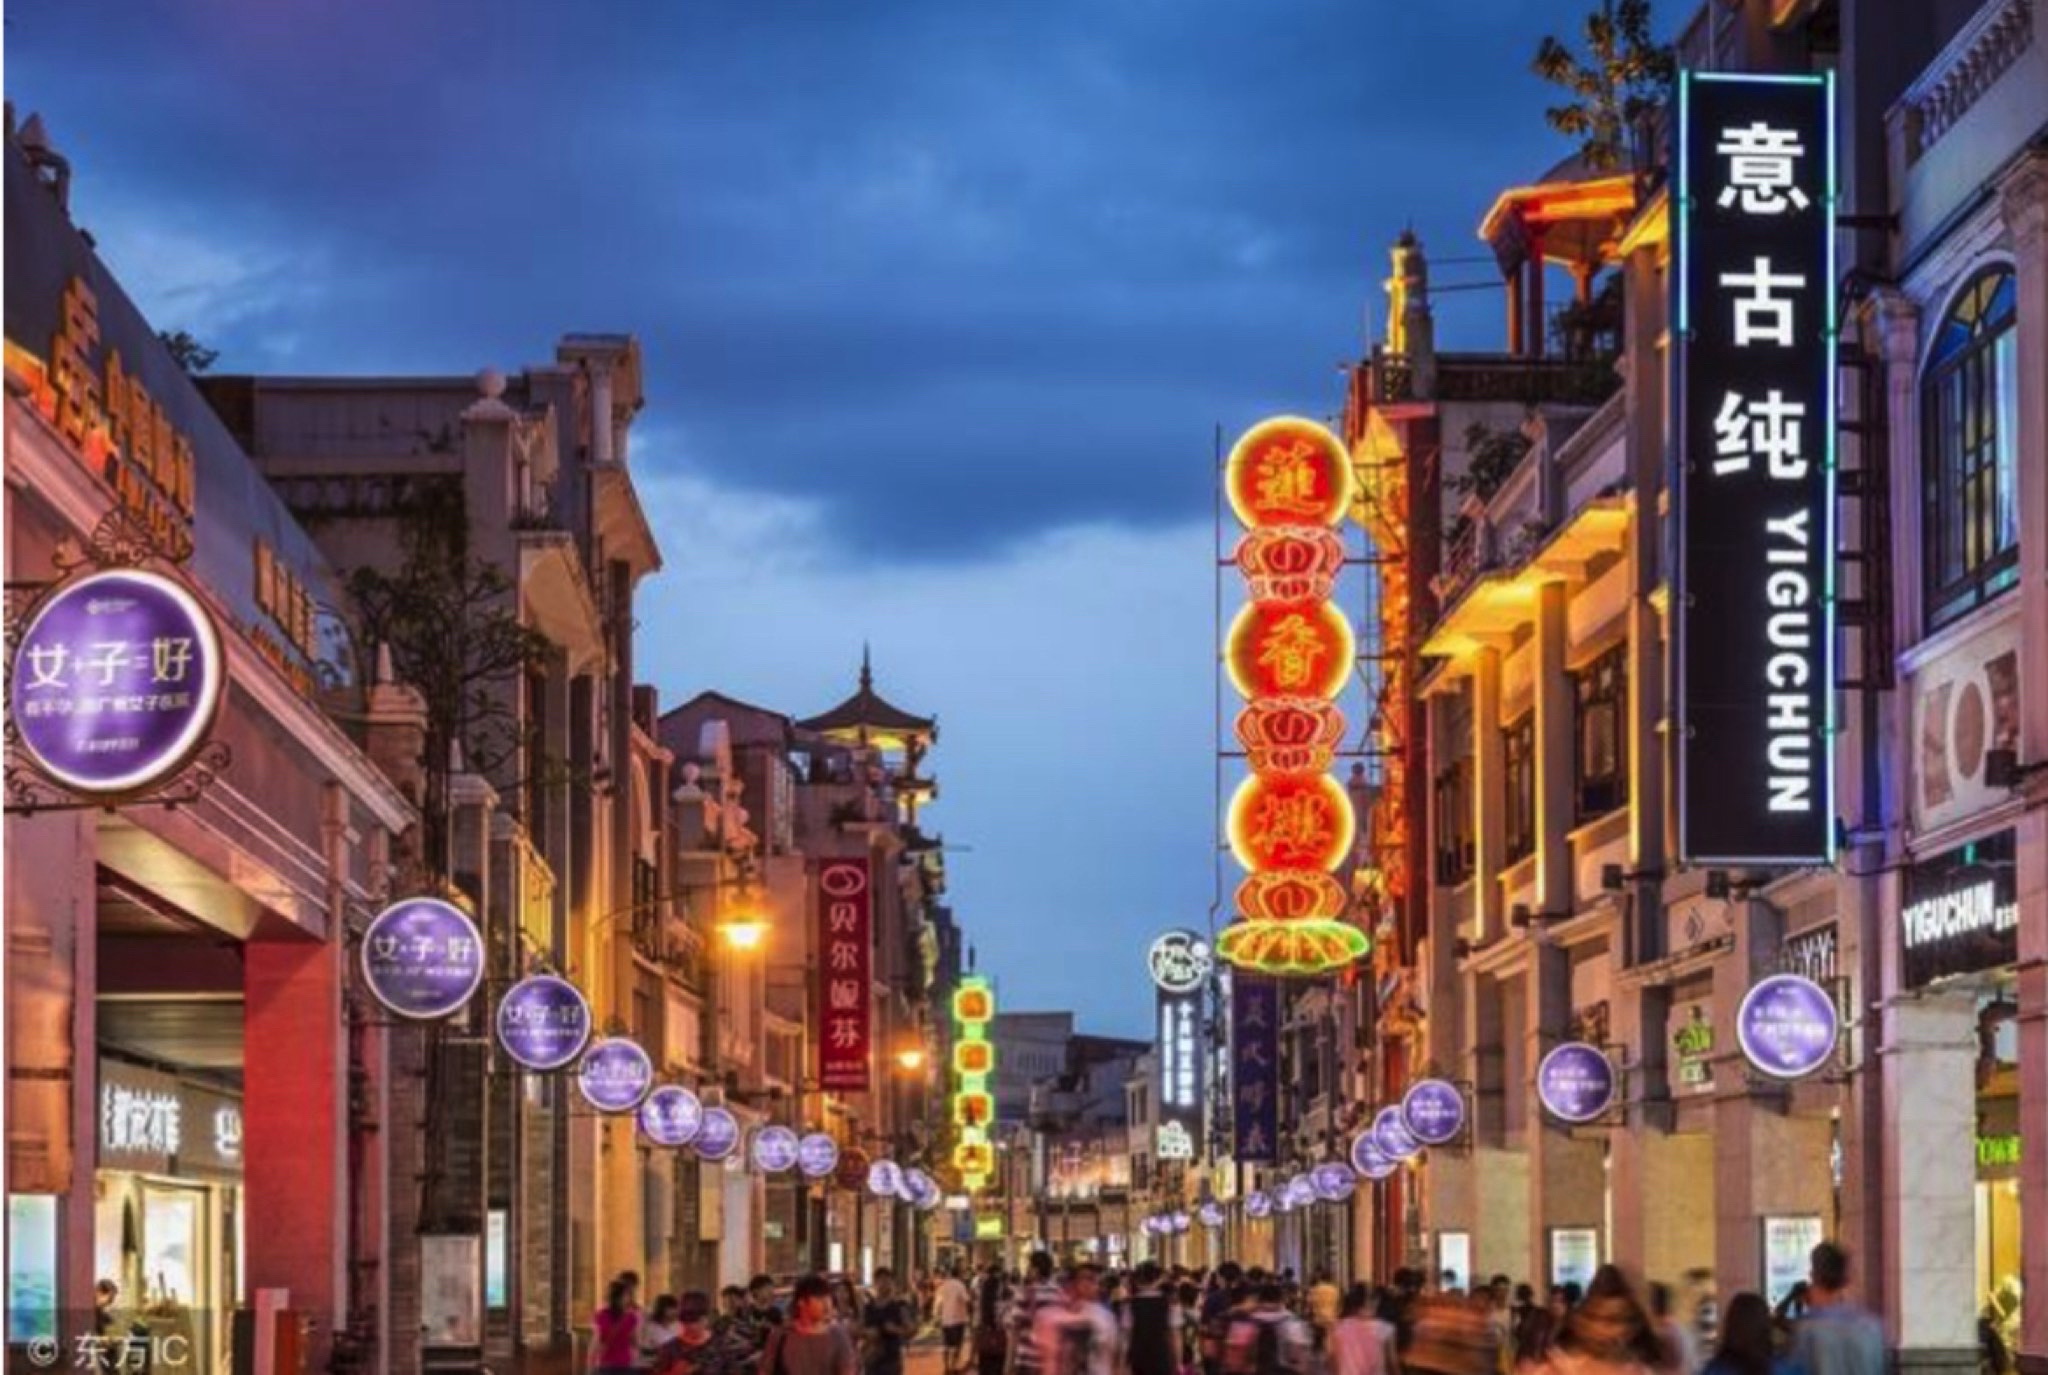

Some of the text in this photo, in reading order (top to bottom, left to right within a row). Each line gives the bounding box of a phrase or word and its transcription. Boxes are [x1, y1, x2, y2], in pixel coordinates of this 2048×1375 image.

[1713, 121, 1810, 480] 意古纯
[1766, 507, 1810, 812] YIGUCHUN
[1902, 879, 1995, 949] YIGUCHUN
